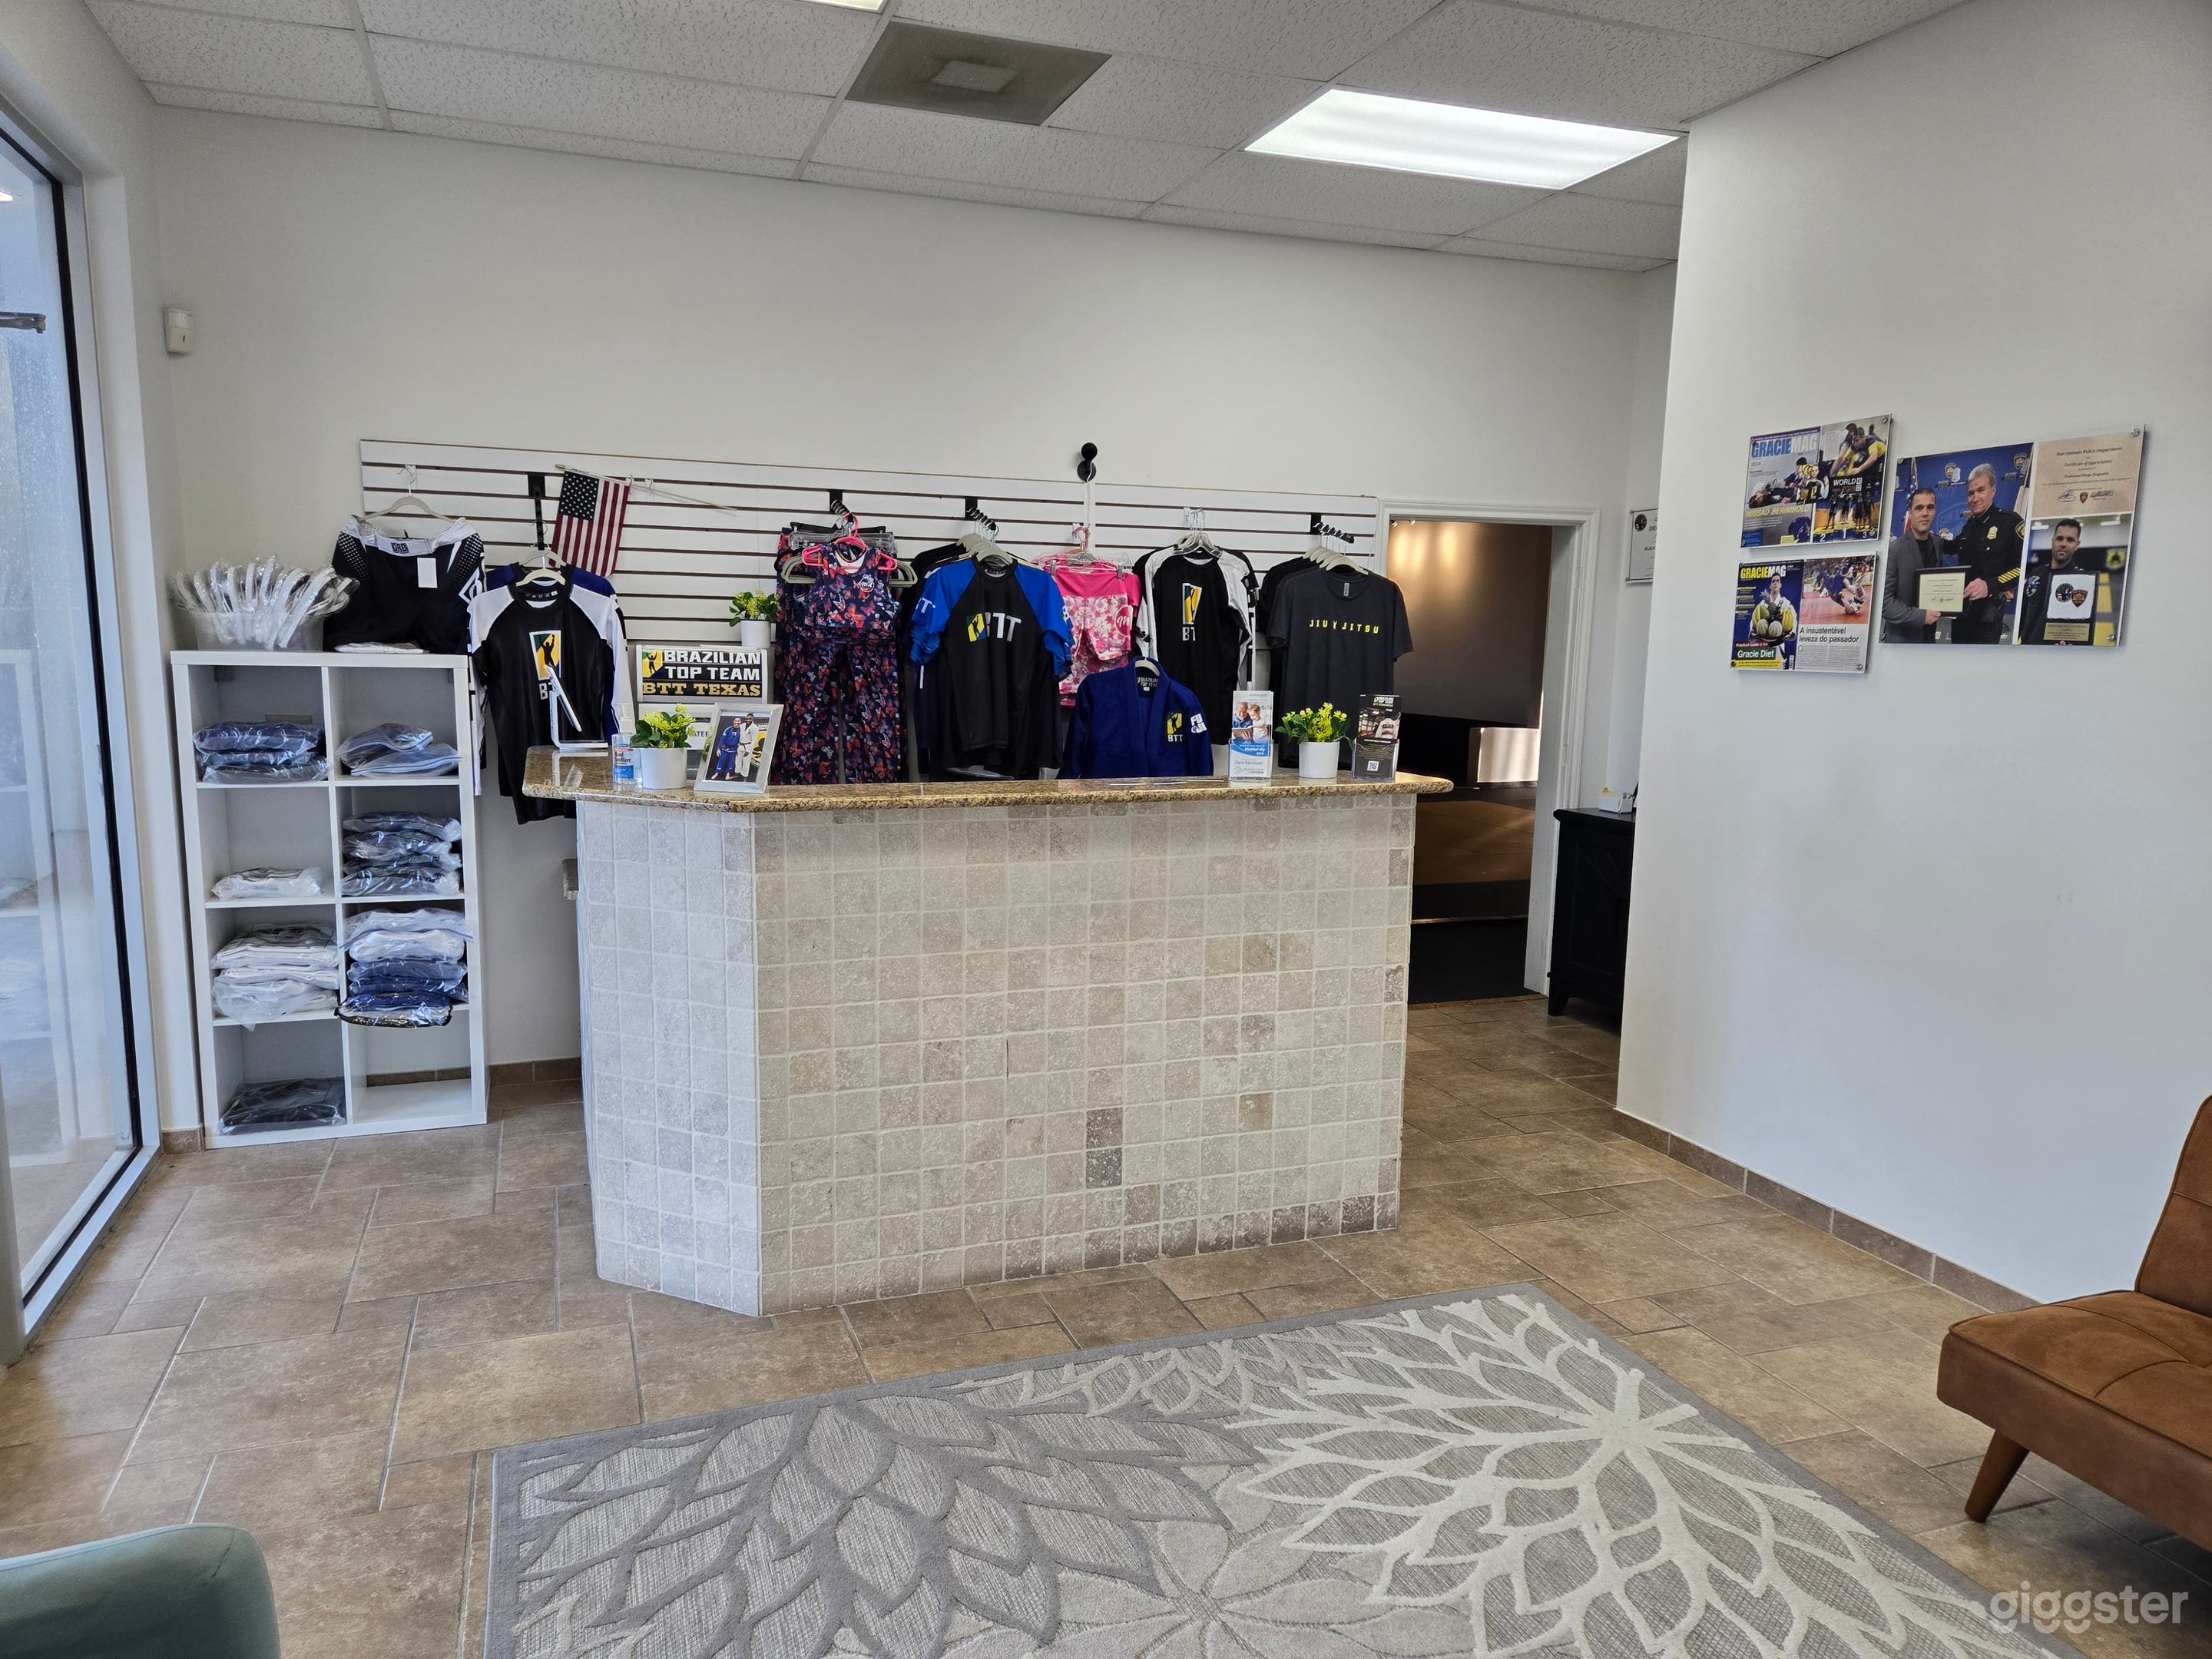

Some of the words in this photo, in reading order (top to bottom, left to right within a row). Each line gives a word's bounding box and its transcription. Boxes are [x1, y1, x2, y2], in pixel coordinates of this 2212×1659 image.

[1771, 505, 1810, 515] BERIMBOLO
[1309, 619, 1328, 628] JIU
[1342, 622, 1379, 634] JITSU
[664, 651, 761, 664] BRAZILIAN
[1737, 650, 1760, 658] Gracie
[664, 666, 702, 680] TOP
[707, 667, 760, 680] TEAM
[642, 683, 687, 694] BTT
[693, 683, 761, 697] TEXAS
